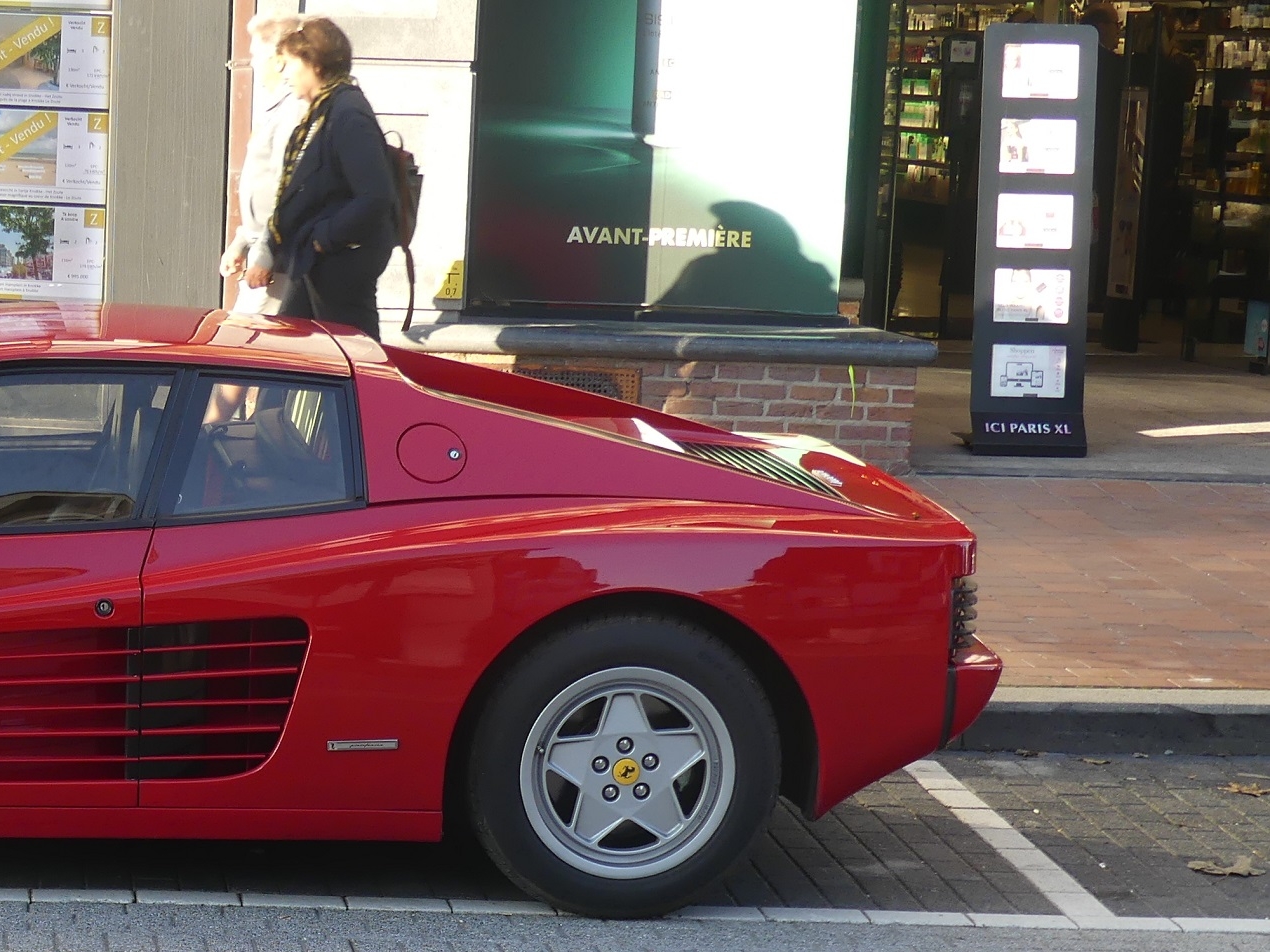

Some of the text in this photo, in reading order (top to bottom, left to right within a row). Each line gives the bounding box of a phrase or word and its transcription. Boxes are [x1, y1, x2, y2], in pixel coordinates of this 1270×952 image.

[97, 22, 105, 34] Z
[12, 23, 49, 50] Vendu
[93, 118, 101, 130] Z
[10, 118, 45, 145] Vendu
[90, 213, 98, 225] Z
[566, 225, 752, 248] AVANT-PREMIÈRE
[985, 422, 1072, 434] ICI PARIS XL
